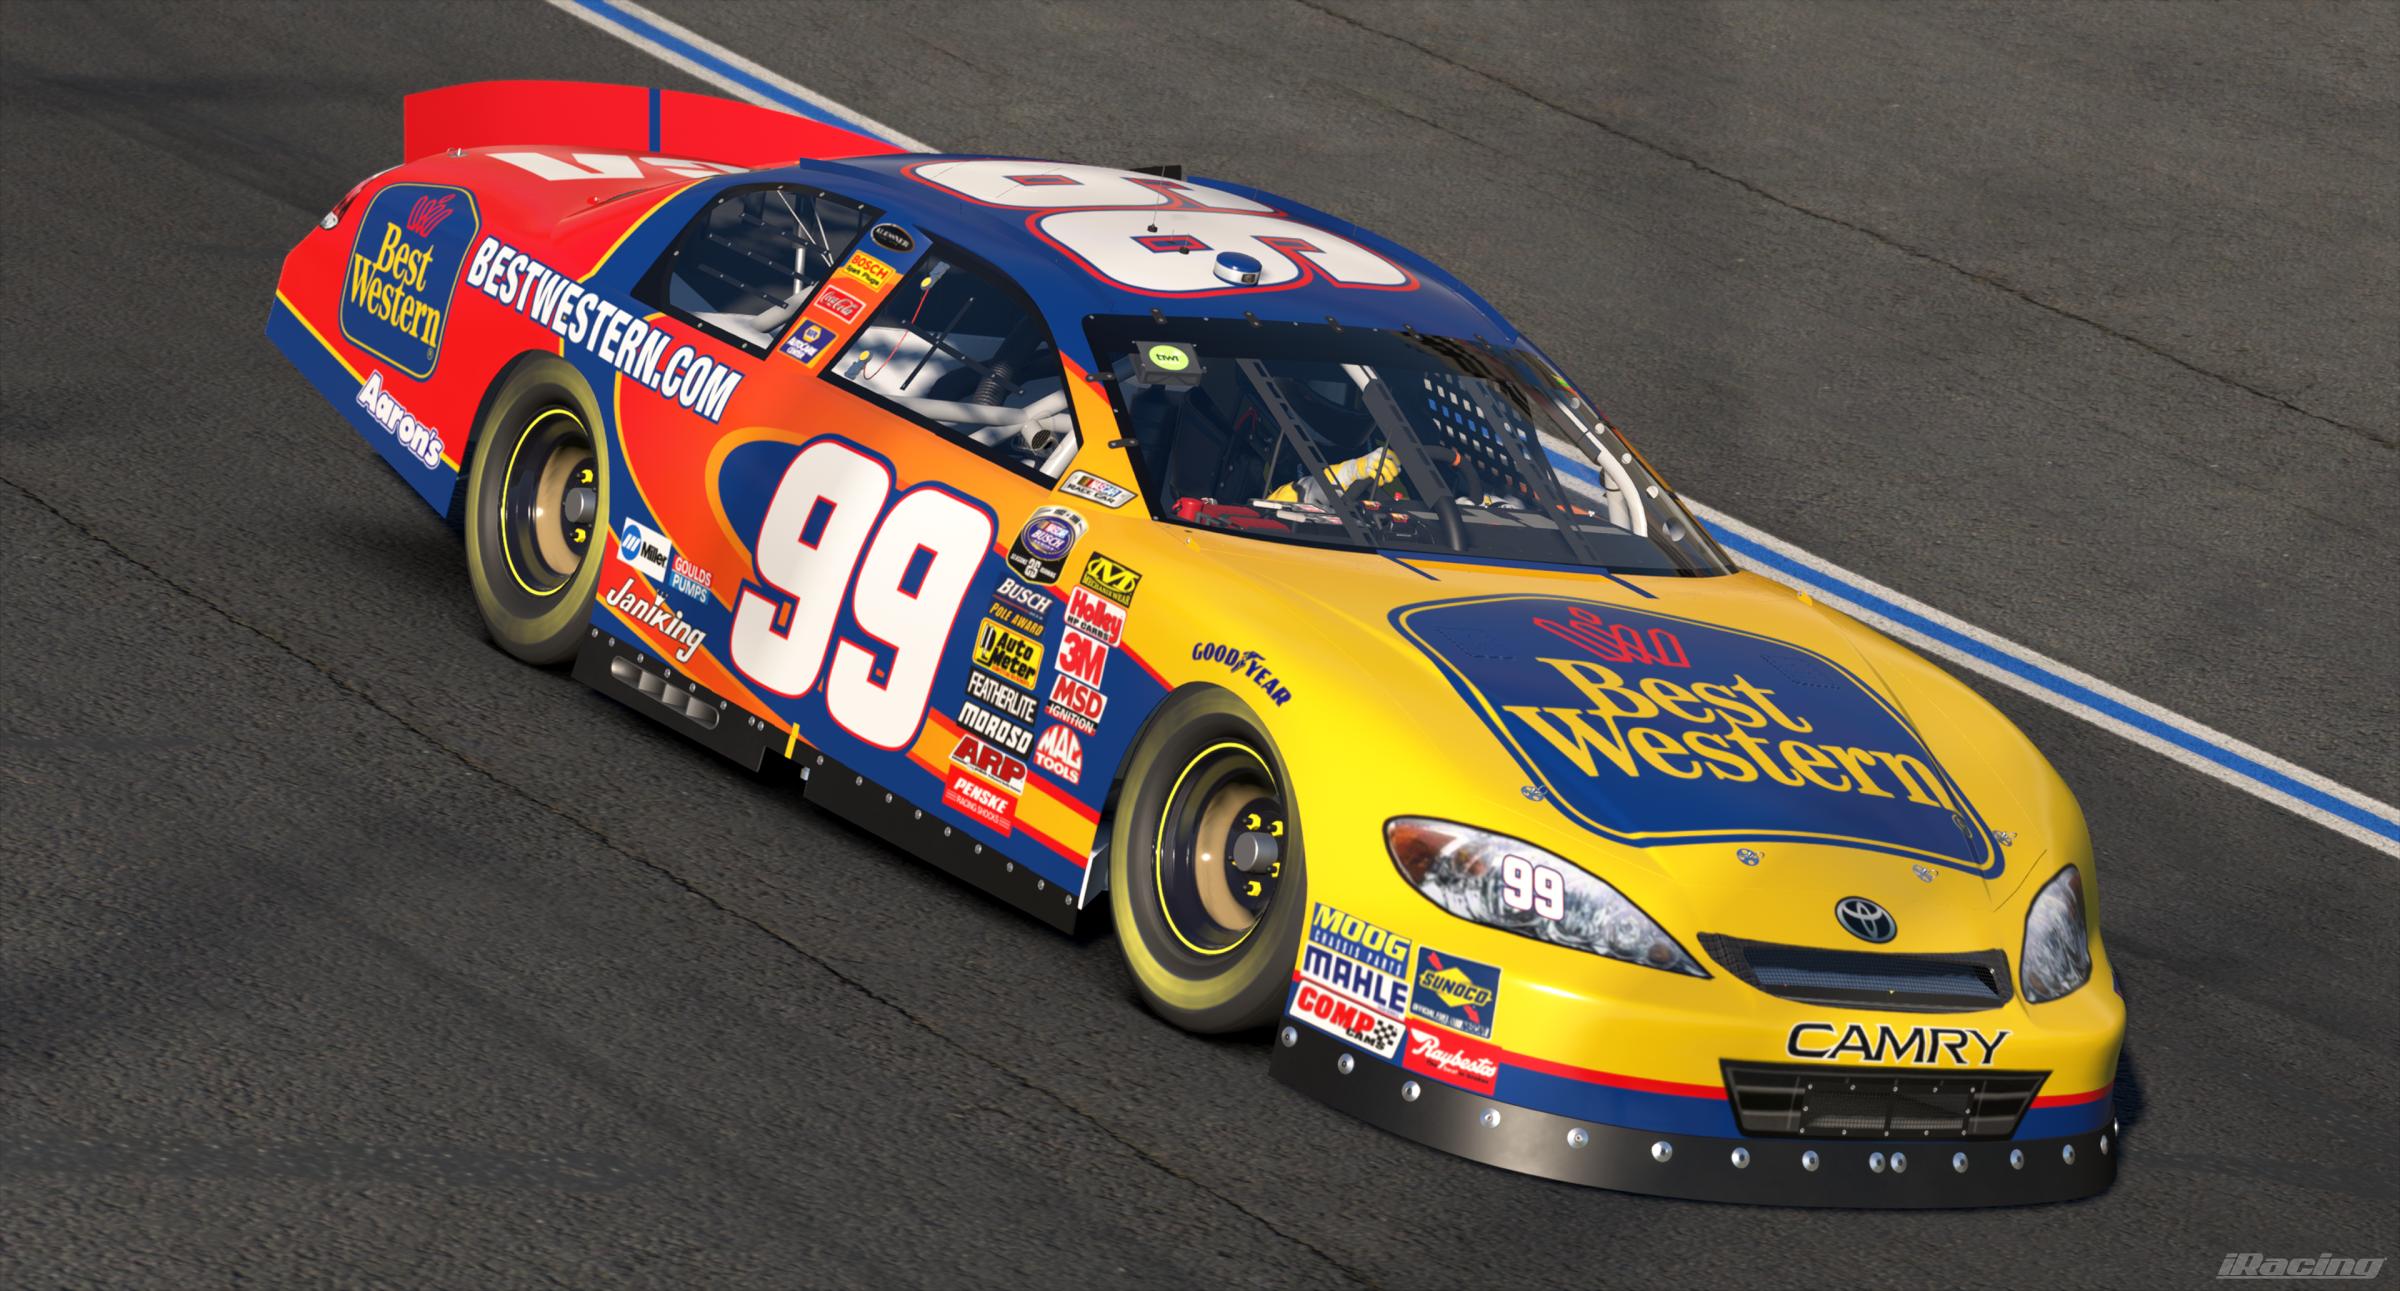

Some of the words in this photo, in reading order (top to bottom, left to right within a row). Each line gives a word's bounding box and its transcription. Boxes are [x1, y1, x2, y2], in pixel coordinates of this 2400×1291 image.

[375, 221, 433, 297] Best
[851, 254, 888, 279] BOSCH
[350, 253, 441, 348] Western
[467, 235, 745, 424] BESTWESTERN.COM
[357, 370, 444, 468] Aaron's
[1067, 483, 1093, 498] RACE
[1094, 491, 1116, 504] CAR
[641, 541, 667, 567] Miller
[1031, 529, 1065, 549] BUSCH
[672, 574, 707, 603] PUMPS
[675, 556, 713, 586] GOULDS
[729, 439, 994, 751] 99
[997, 578, 1052, 614] BUSCH
[1069, 589, 1122, 644] Holley
[989, 602, 1011, 622] POLE
[1011, 612, 1045, 636] AWARD
[1067, 615, 1081, 627] HP
[991, 648, 1036, 681] Meter
[995, 632, 1034, 661] Auto
[1059, 631, 1107, 687] 3M
[1192, 642, 1292, 708] GOODYEAR
[1536, 657, 1813, 733] Best
[967, 671, 1037, 724] FEATHERLITE
[1049, 703, 1095, 734] IGNITION
[1052, 676, 1103, 719] MSD
[958, 701, 1034, 754] MOROSO
[1037, 727, 1082, 768] MAC
[953, 736, 1026, 784] ARP
[1035, 752, 1079, 784] TOOLS
[1503, 705, 1962, 815] Western
[954, 777, 1008, 815] PENSKE
[1502, 854, 1565, 921] 99
[1314, 905, 1411, 961] MOOG
[1314, 930, 1360, 959] CHASSIS
[1367, 948, 1403, 976] PARTS
[1303, 944, 1409, 1014] MAHLE
[1422, 972, 1488, 1005] SUNOCO
[1297, 986, 1375, 1034] COMP
[1345, 1027, 1386, 1051] CAMS
[1410, 1027, 1496, 1078] Raybestos
[1787, 1022, 2010, 1065] CAMRY
